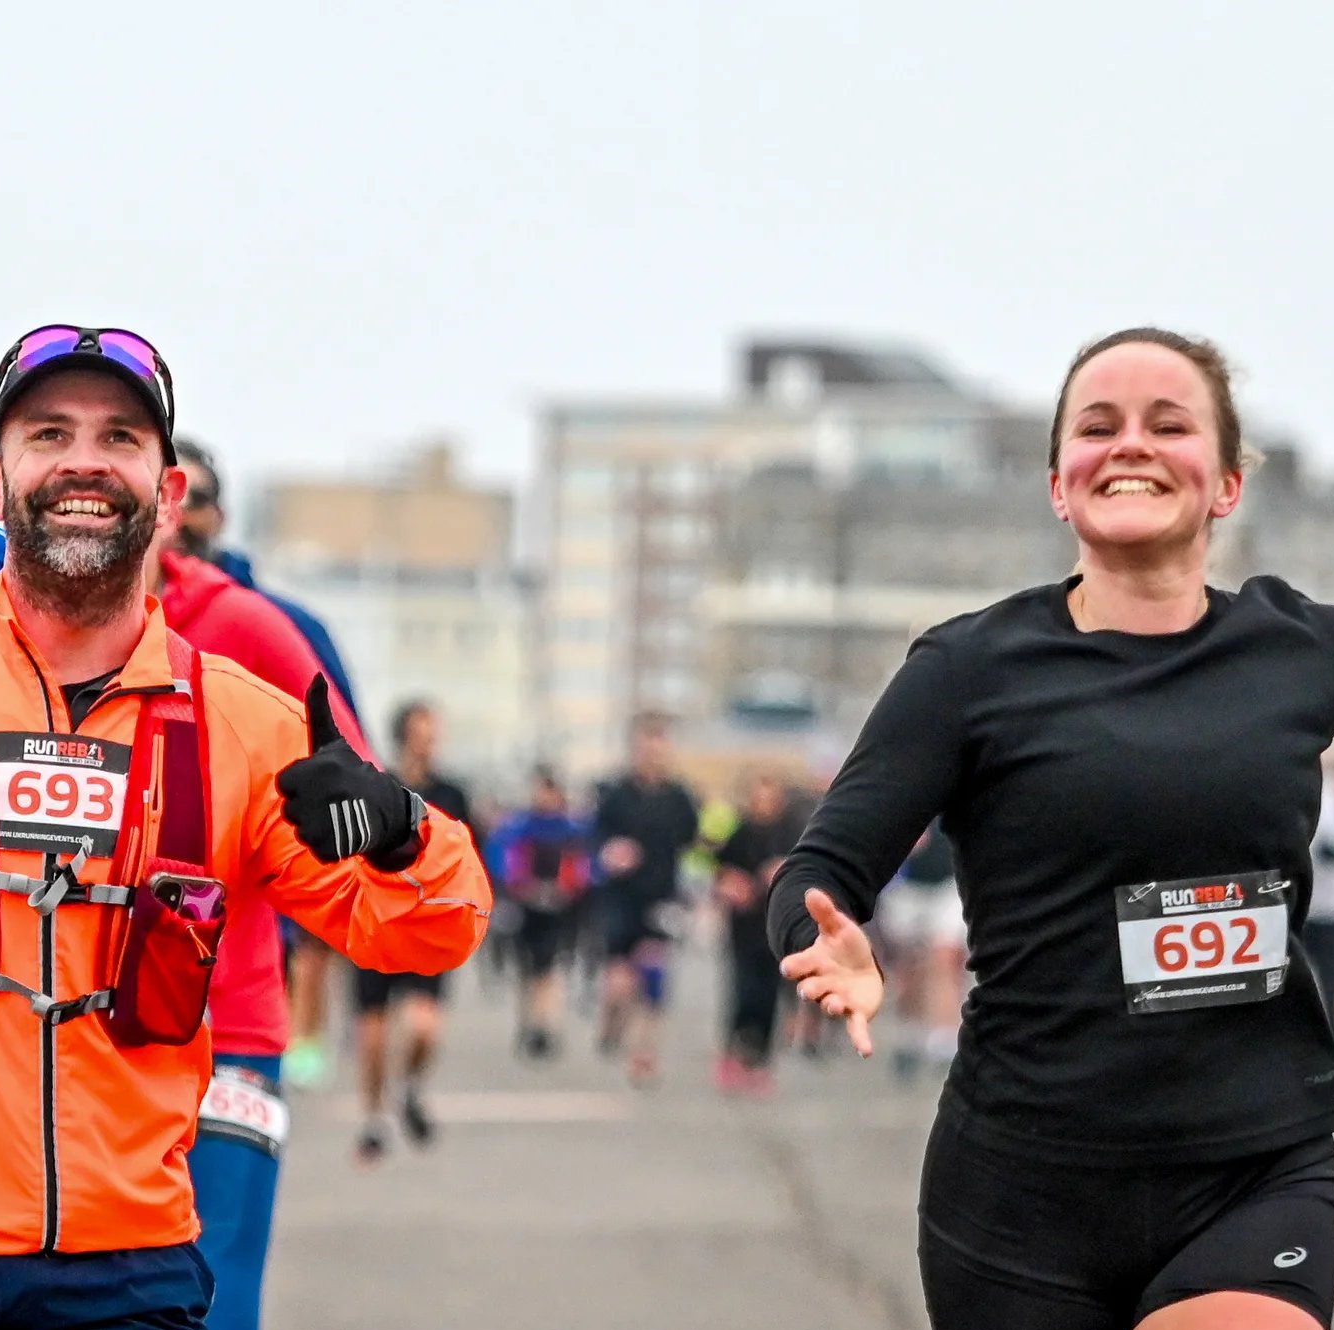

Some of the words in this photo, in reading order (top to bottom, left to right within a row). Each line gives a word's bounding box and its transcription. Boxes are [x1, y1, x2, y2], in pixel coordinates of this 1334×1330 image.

[23, 738, 105, 762] RUNREBL
[8, 770, 114, 822] 693
[1160, 881, 1244, 907] RUNREBL
[1153, 916, 1260, 973] 692
